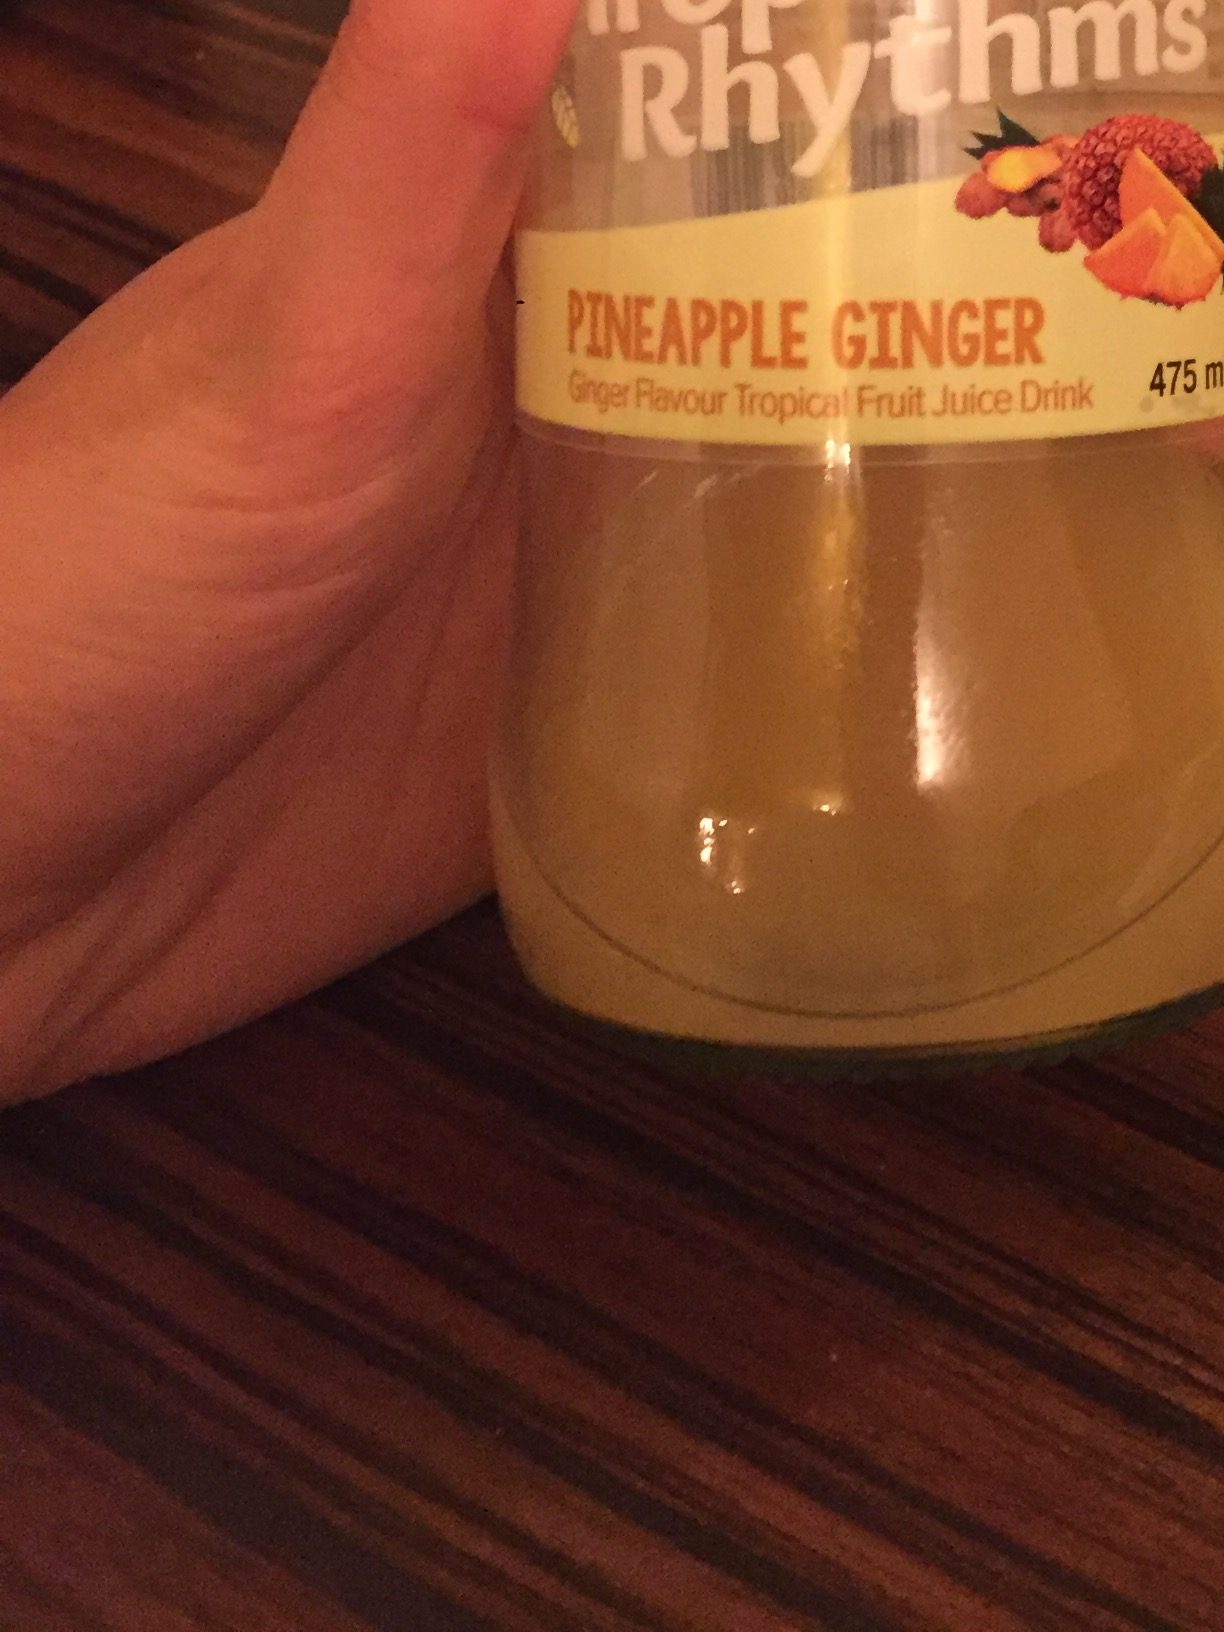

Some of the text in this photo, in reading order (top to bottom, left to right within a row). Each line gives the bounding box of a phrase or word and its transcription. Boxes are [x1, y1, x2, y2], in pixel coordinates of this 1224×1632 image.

[567, 287, 1046, 371] PINEAPPLE GINGER
[568, 369, 1096, 426] Ginger Flavour Tropical Fruit Juice Drink
[1149, 358, 1198, 398] 475
